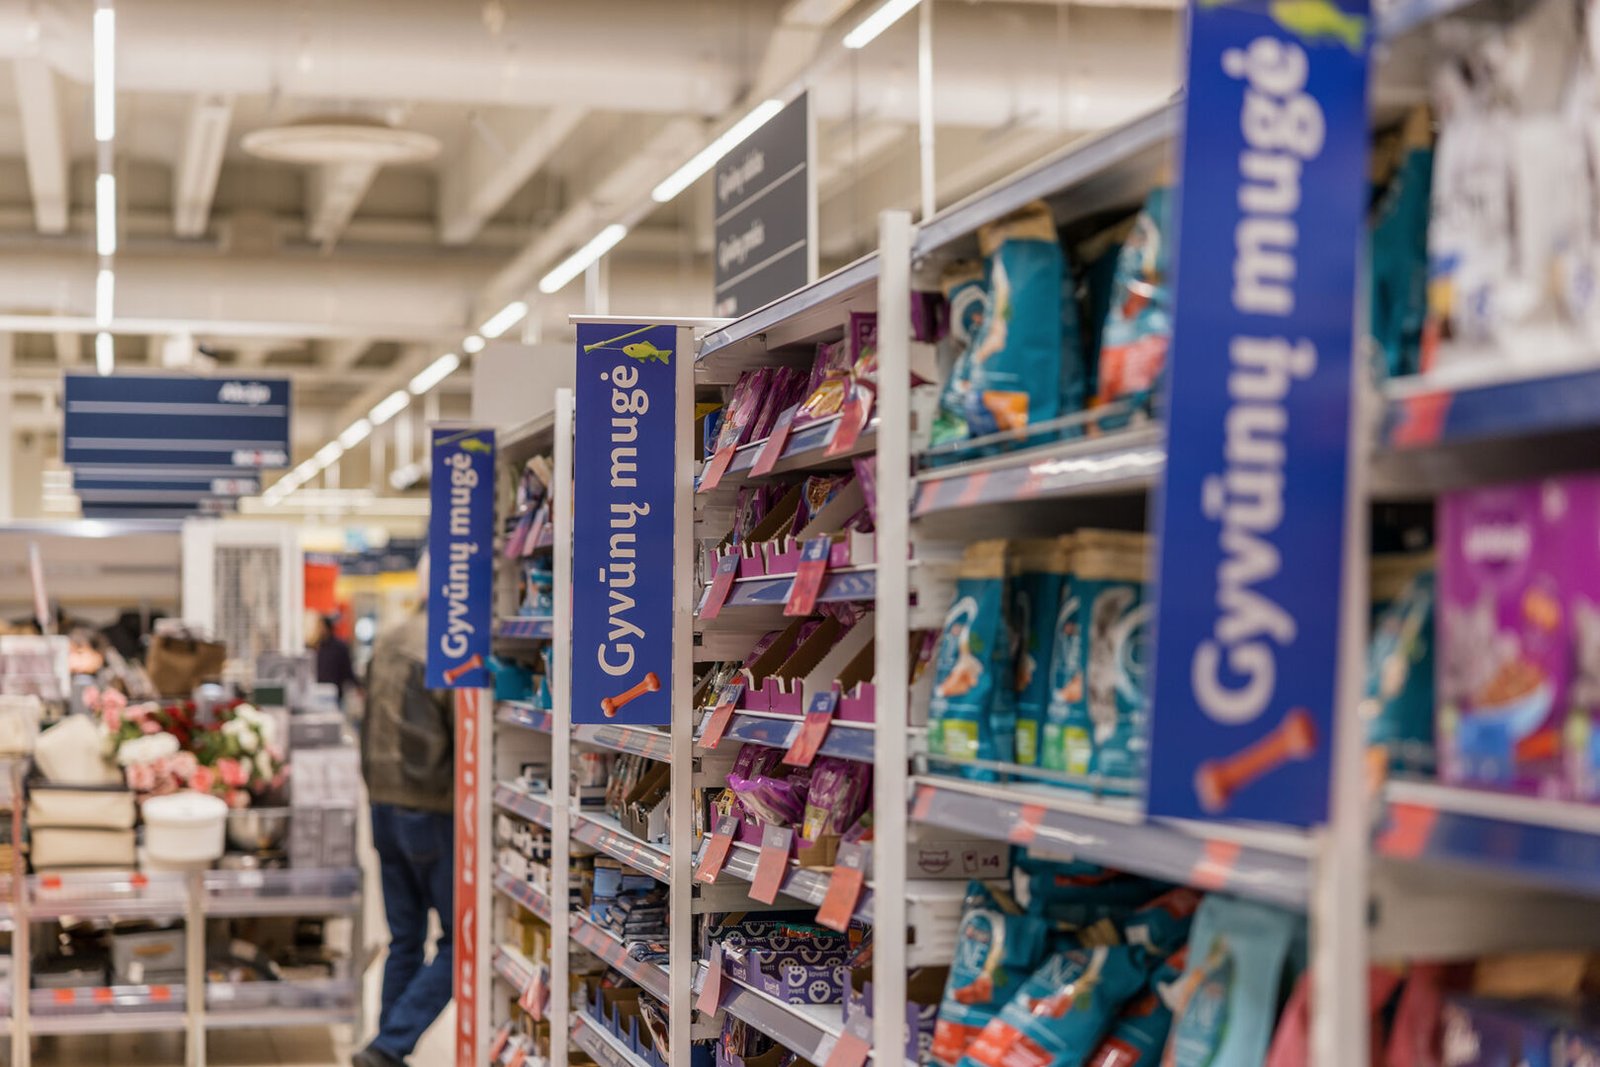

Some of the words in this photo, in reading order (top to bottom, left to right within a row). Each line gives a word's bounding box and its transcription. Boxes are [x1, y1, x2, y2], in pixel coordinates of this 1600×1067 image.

[1221, 35, 1326, 315] mugė
[444, 453, 479, 535] mugė
[600, 365, 650, 488] mugė
[441, 542, 479, 658] Gyvūnų
[598, 502, 650, 676] Gyvūnų
[1191, 337, 1318, 725] Gyvūnų
